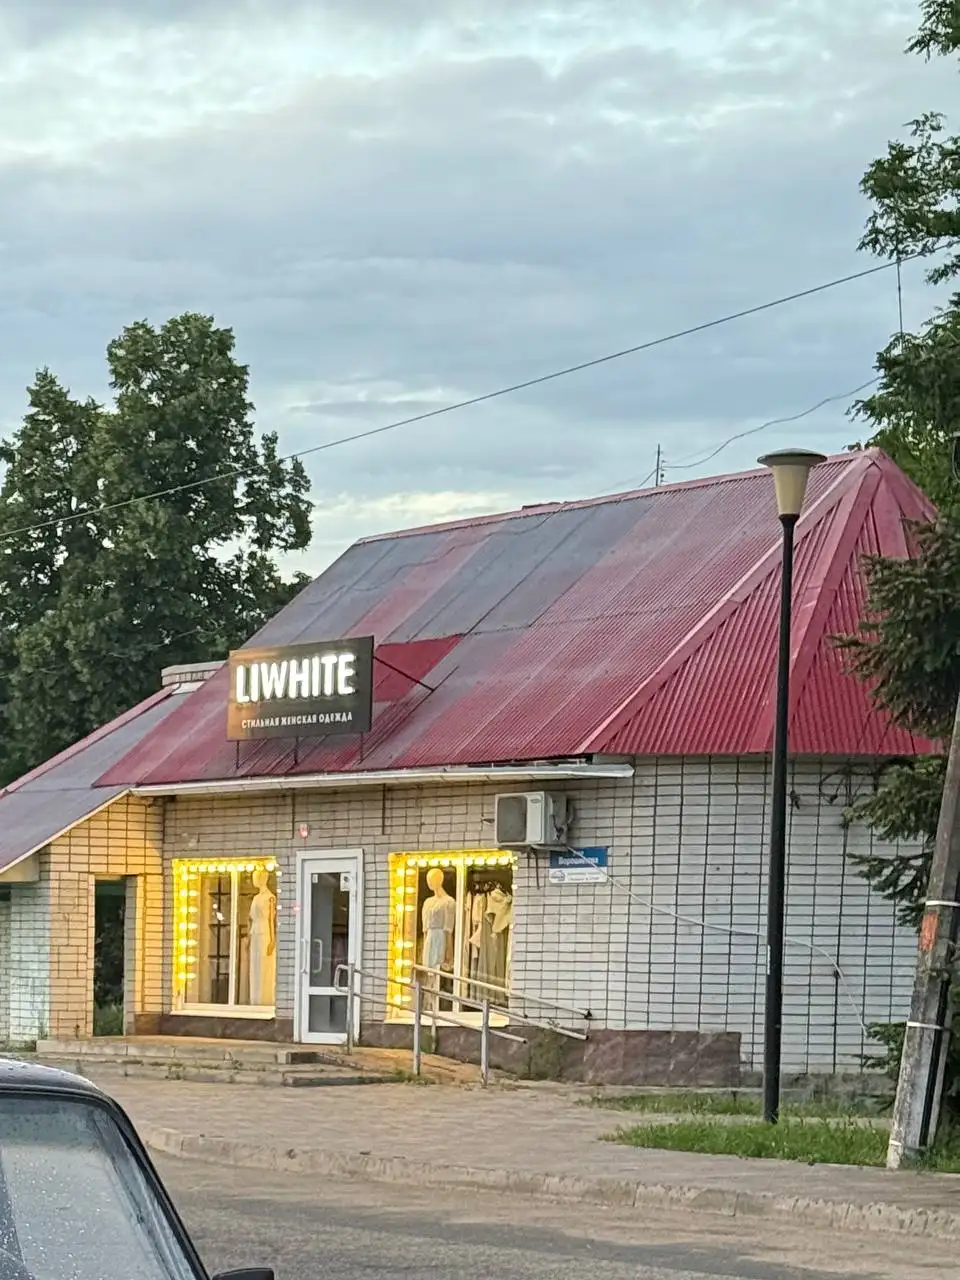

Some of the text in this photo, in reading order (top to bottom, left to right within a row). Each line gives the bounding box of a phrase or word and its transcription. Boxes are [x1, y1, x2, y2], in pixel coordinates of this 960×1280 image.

[236, 653, 355, 703] LIWHITE
[242, 711, 352, 729] СТИЛЬНАЯ ЖЕНСКАЯ ОДЕЖДА
